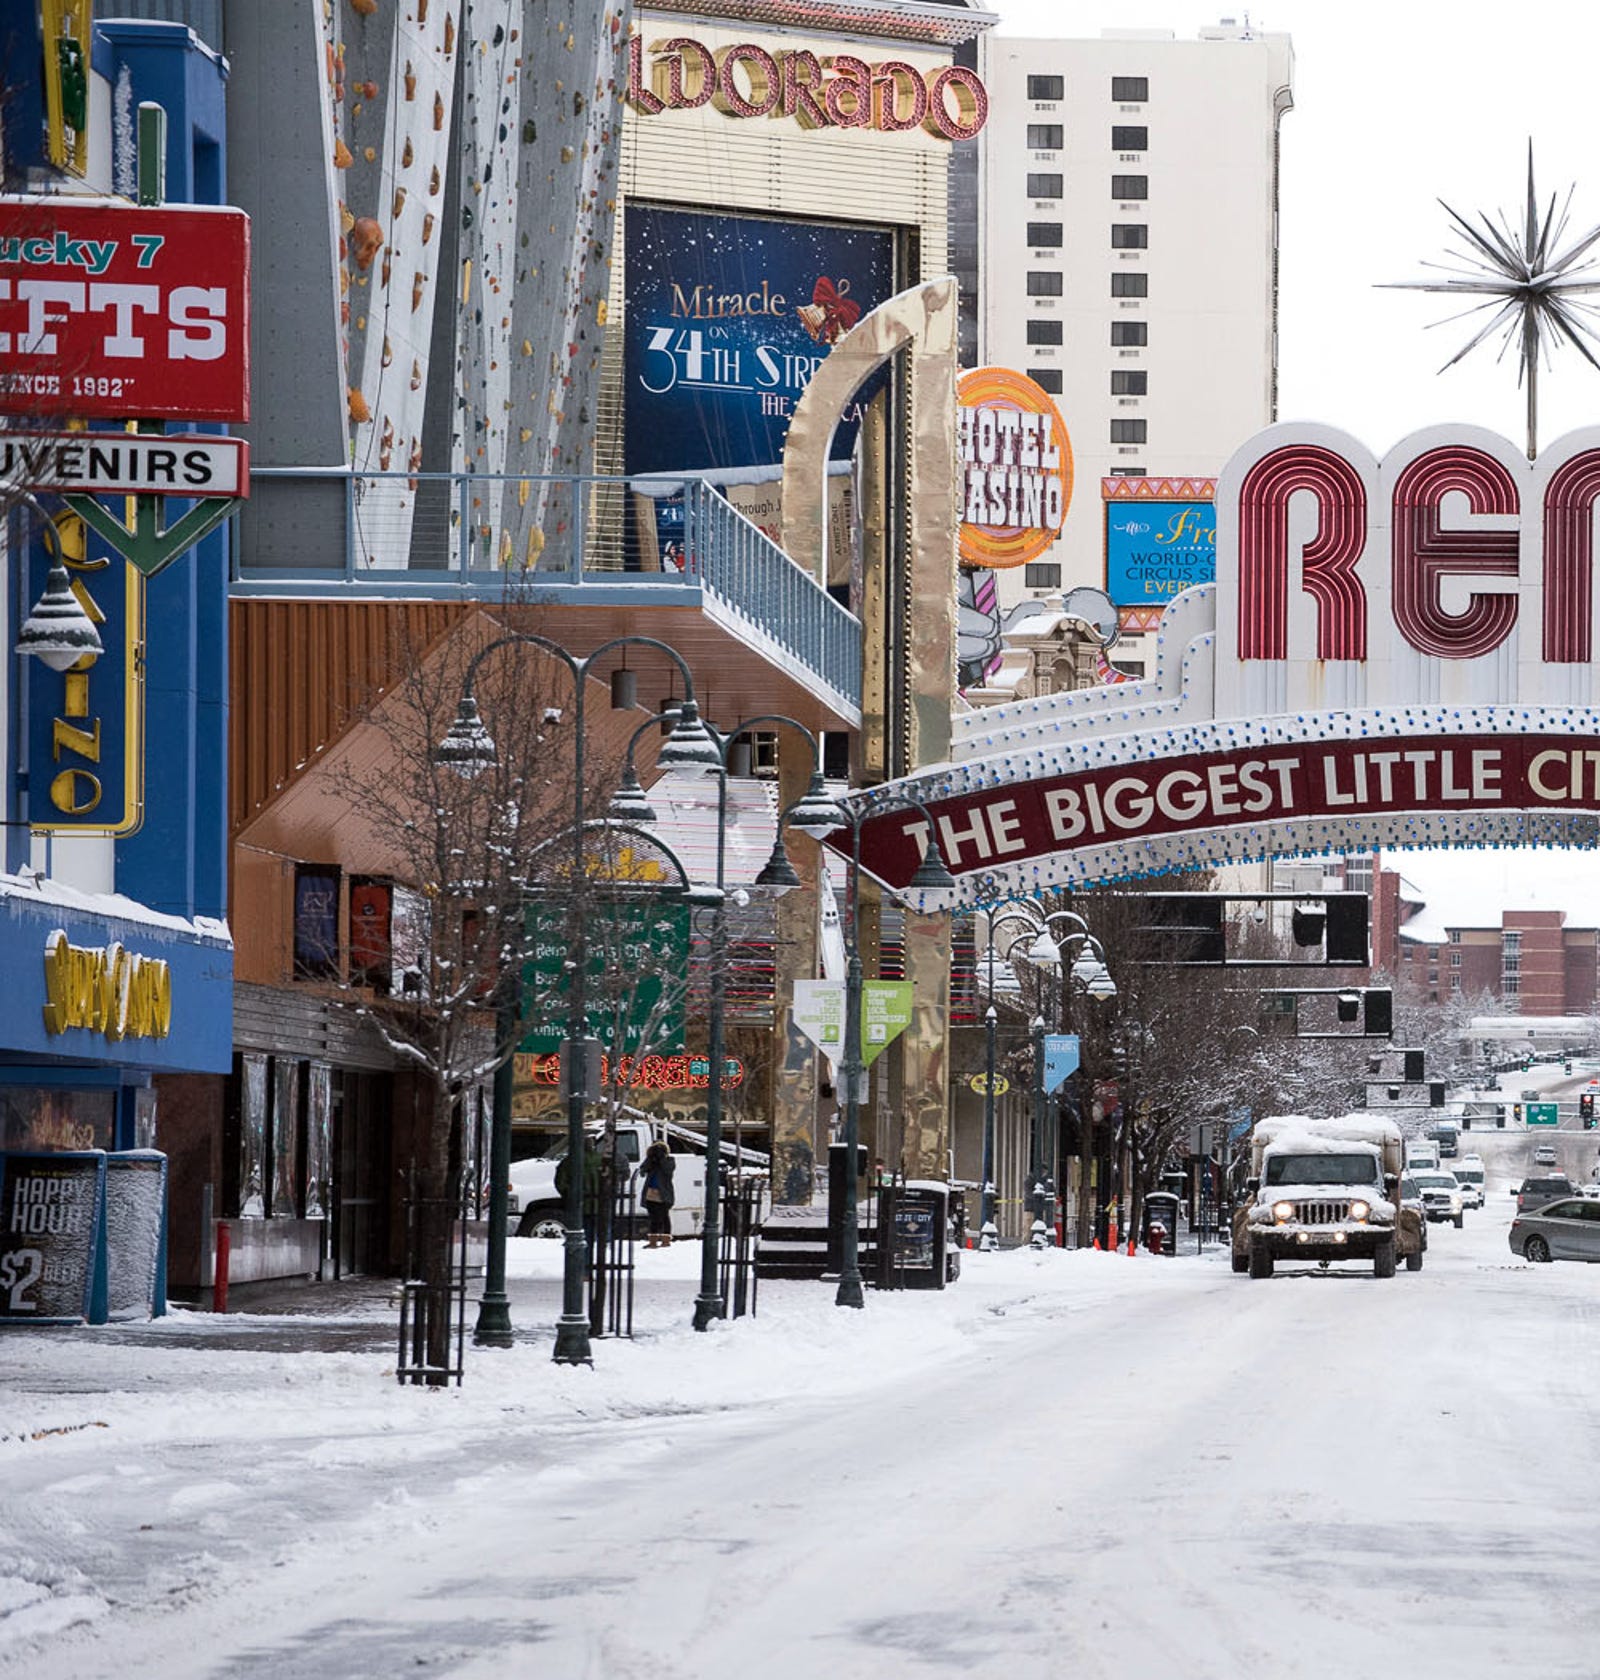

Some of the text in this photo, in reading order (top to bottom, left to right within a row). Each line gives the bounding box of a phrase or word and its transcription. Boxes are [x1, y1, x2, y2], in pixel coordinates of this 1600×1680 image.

[132, 234, 165, 268] 7
[670, 280, 787, 319] Miracle
[708, 326, 729, 340] ON
[640, 326, 740, 394] 34TH
[758, 391, 791, 417] THE
[957, 406, 1061, 469] HOTEL
[959, 470, 1062, 530] ASINO
[1126, 567, 1196, 581] CIRCUS
[44, 508, 110, 815] CINO
[902, 800, 1027, 866] THE
[1045, 758, 1300, 841] BIGGEST
[1323, 750, 1501, 806] LITTLE
[15, 1177, 87, 1204] HAPPY
[11, 1204, 81, 1233] HOUR
[1, 1248, 42, 1310] $2
